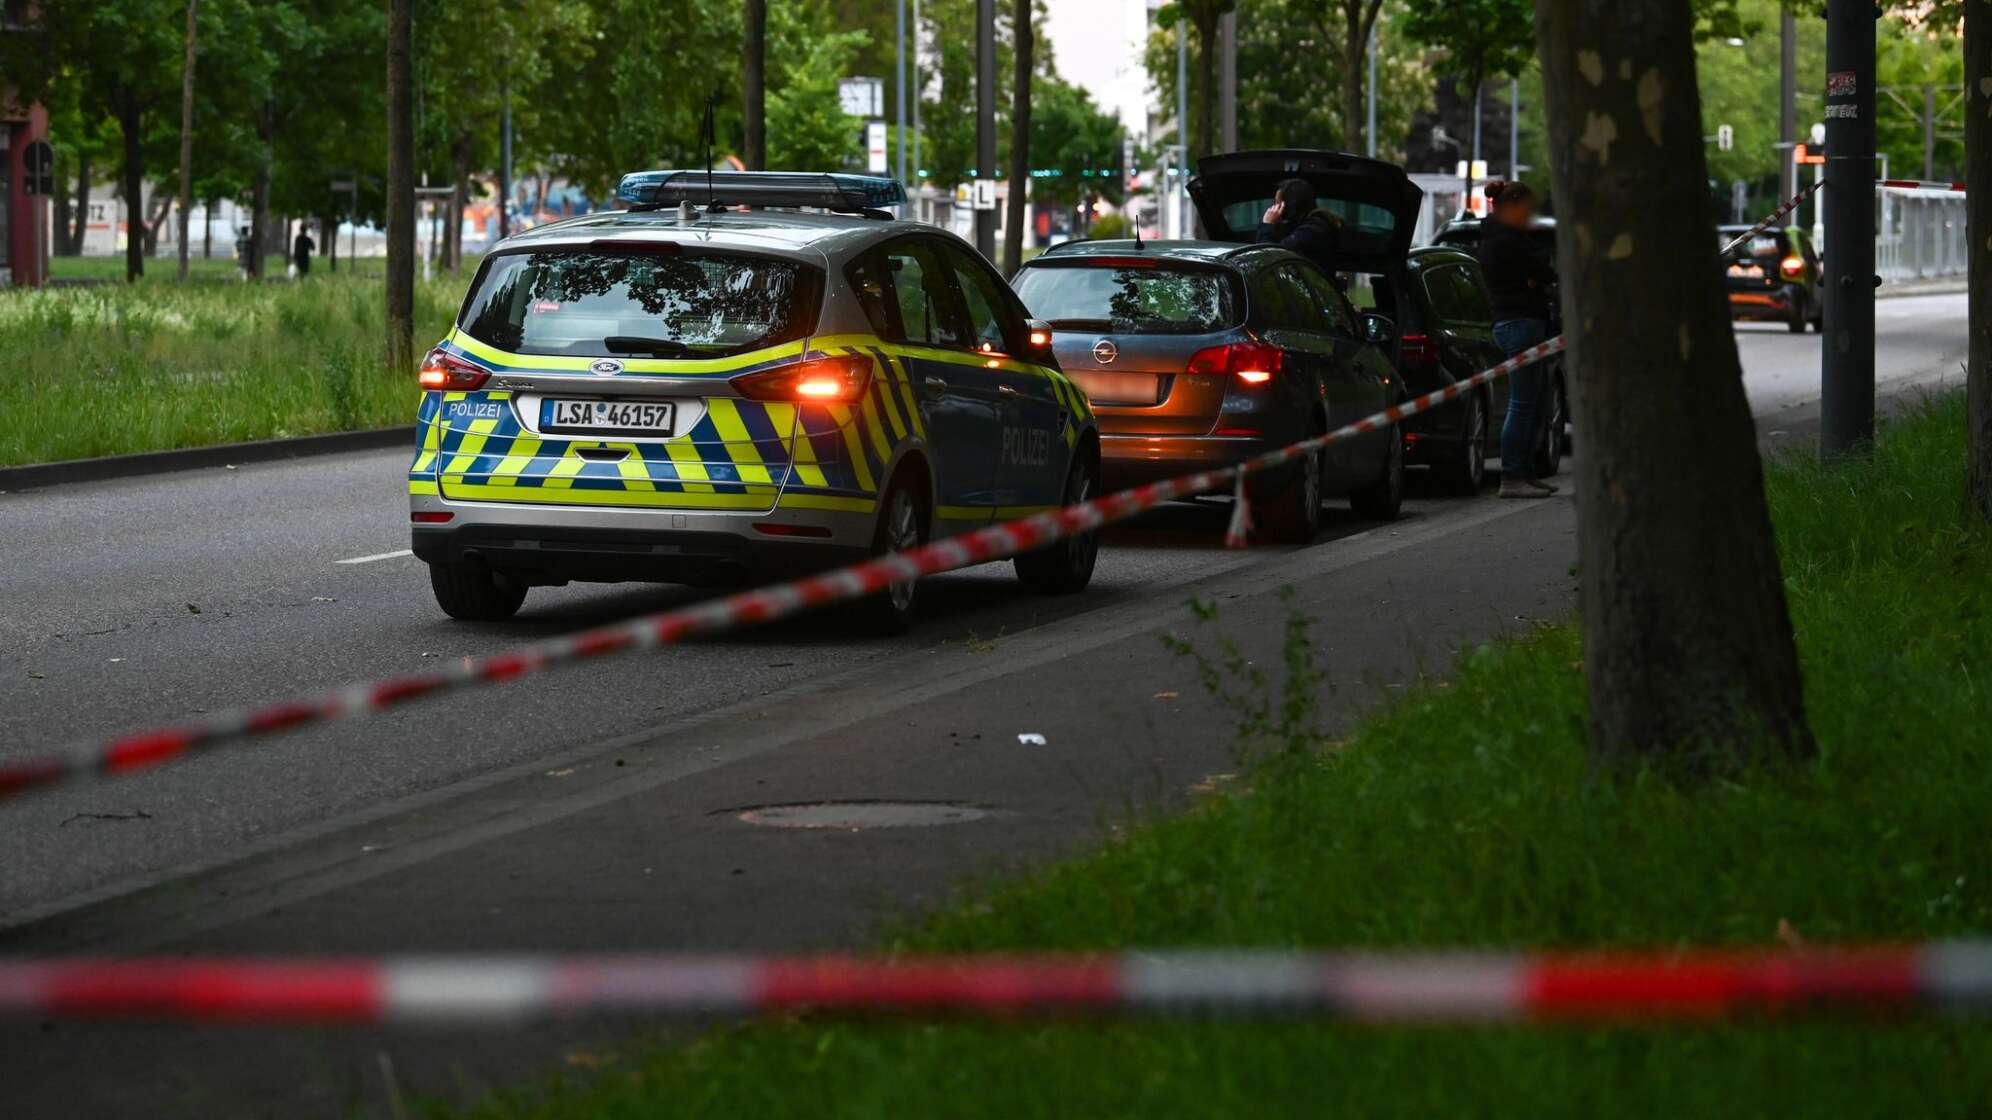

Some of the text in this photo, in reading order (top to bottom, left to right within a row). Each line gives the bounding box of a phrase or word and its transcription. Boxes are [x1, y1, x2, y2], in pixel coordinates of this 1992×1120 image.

[448, 402, 502, 418] POLIZEI
[556, 402, 592, 425] LSA
[608, 404, 667, 427] 46157
[1001, 426, 1049, 466] POLIZEI
